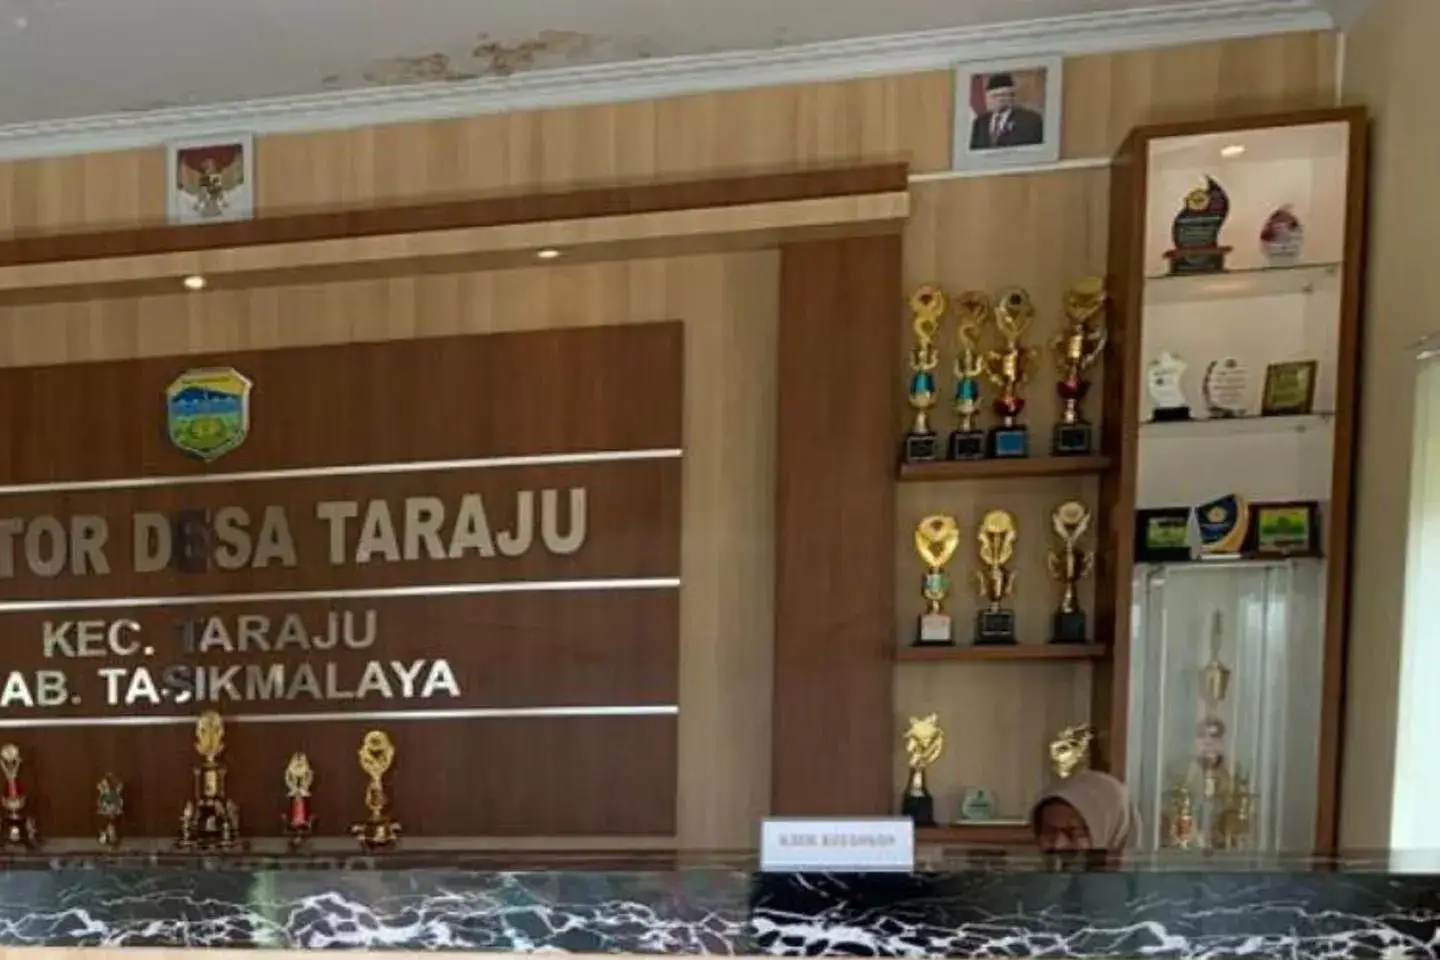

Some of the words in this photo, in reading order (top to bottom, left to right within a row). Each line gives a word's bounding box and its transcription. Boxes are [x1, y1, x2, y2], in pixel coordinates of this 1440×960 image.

[133, 505, 298, 574] DESA
[316, 487, 588, 565] TARAJU
[42, 618, 155, 659] KEC.
[176, 609, 378, 654] TARAJU
[97, 658, 461, 705] TASIKMALAYA
